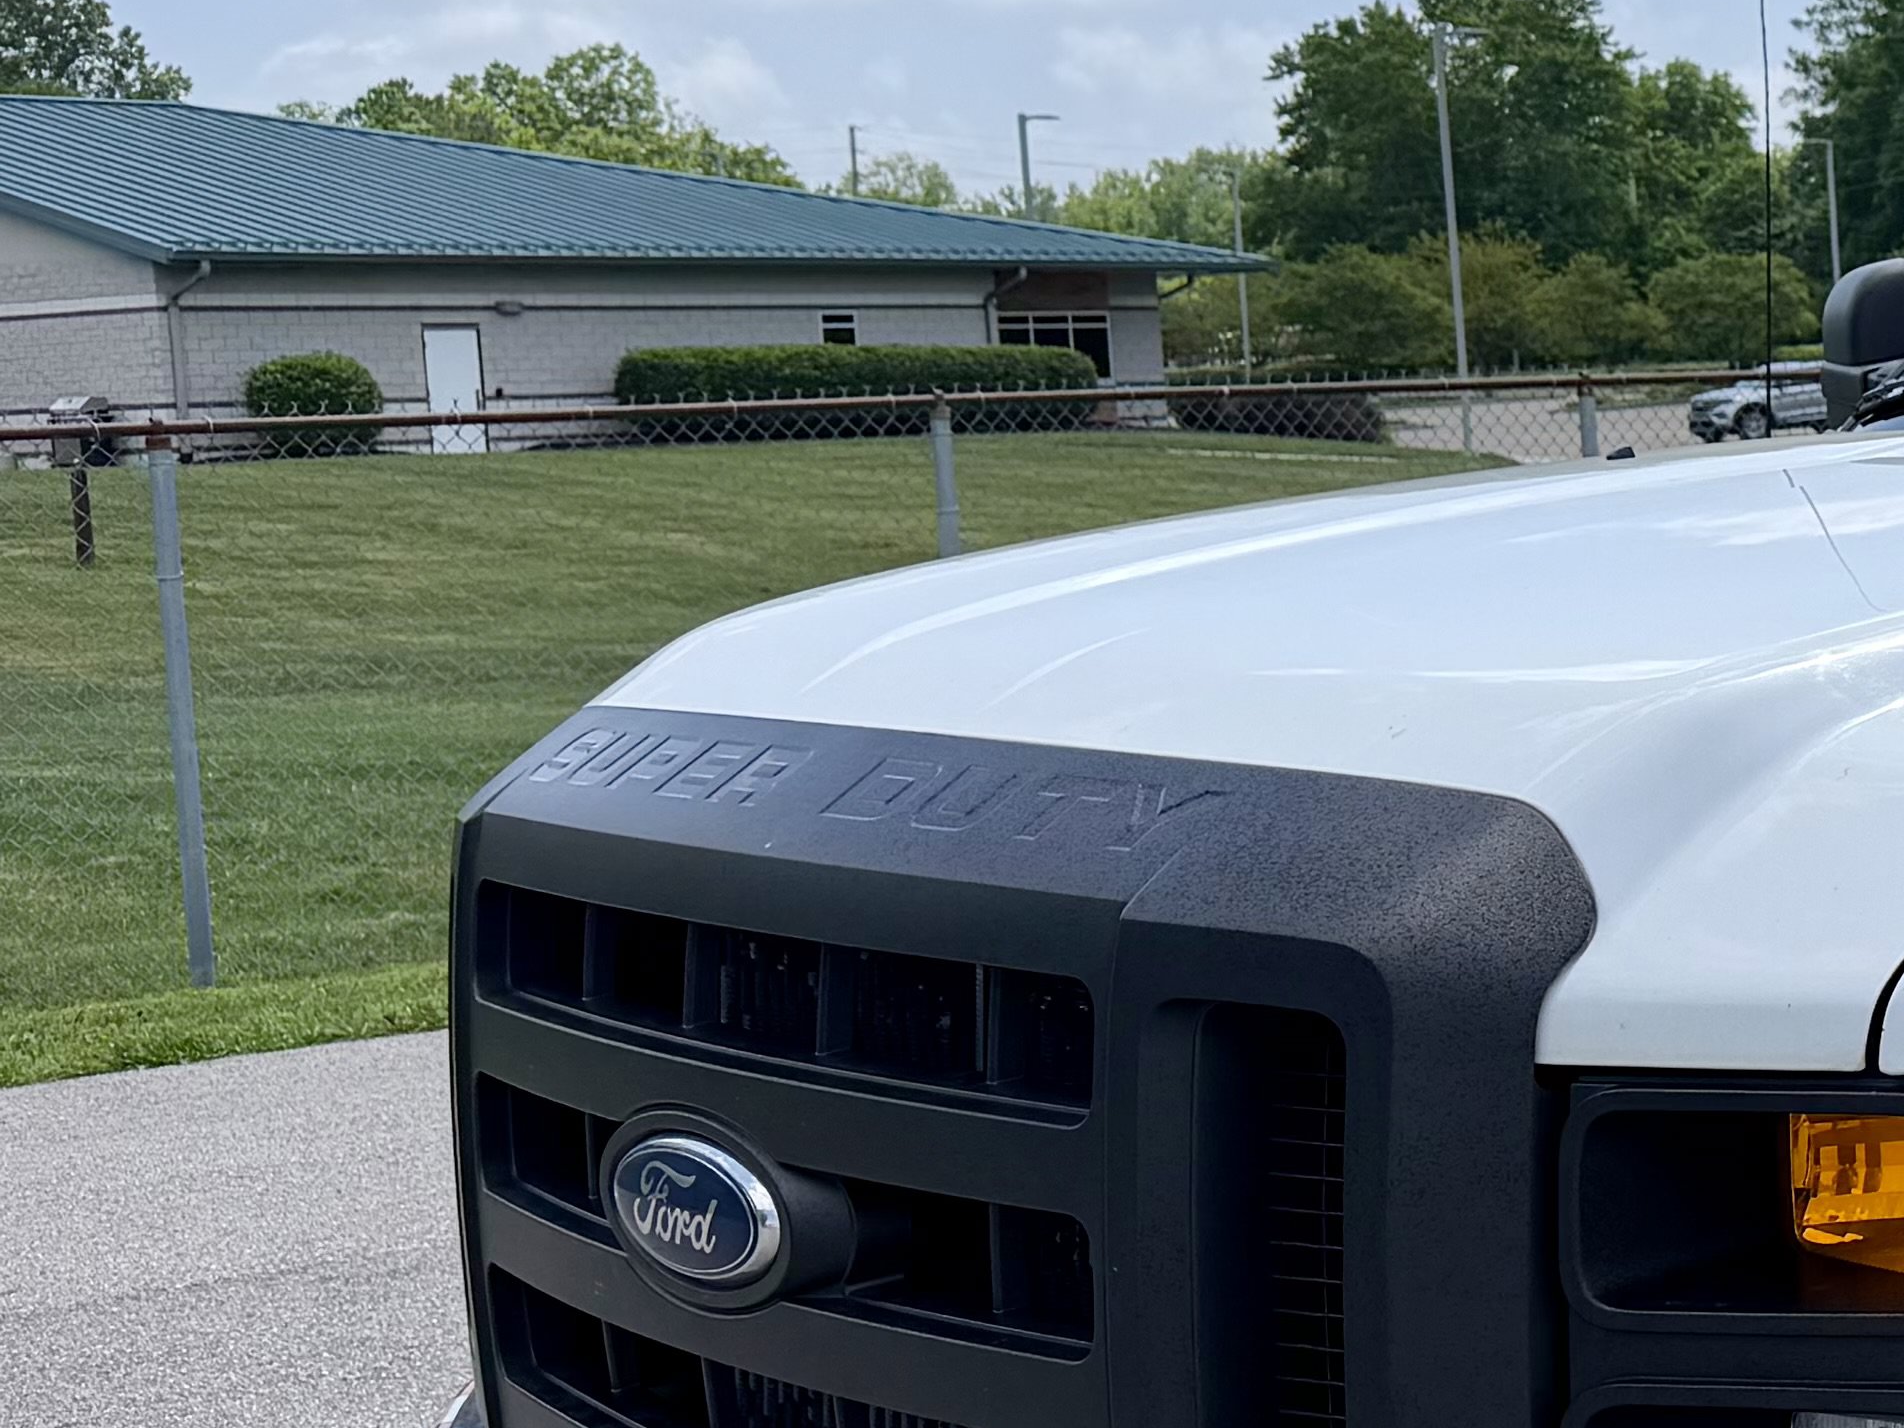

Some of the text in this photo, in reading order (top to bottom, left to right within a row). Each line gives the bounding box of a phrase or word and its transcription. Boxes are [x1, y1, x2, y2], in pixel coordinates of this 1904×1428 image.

[528, 727, 1232, 853] SUPER DUTY
[633, 1160, 717, 1255] Ford
